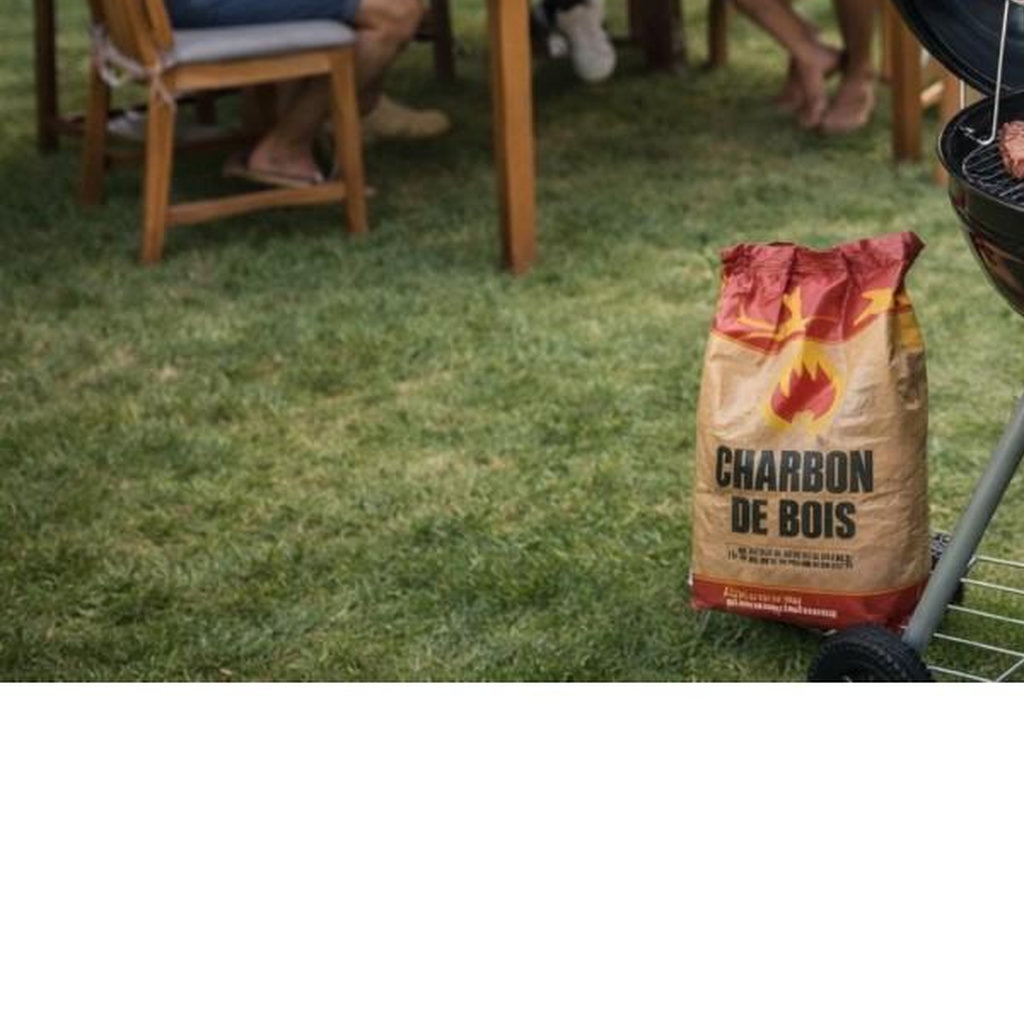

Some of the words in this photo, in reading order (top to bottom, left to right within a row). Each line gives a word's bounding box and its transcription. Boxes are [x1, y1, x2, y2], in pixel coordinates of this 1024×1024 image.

[715, 445, 874, 494] CHARBON
[731, 496, 768, 535] DE
[778, 499, 856, 539] BOIS
